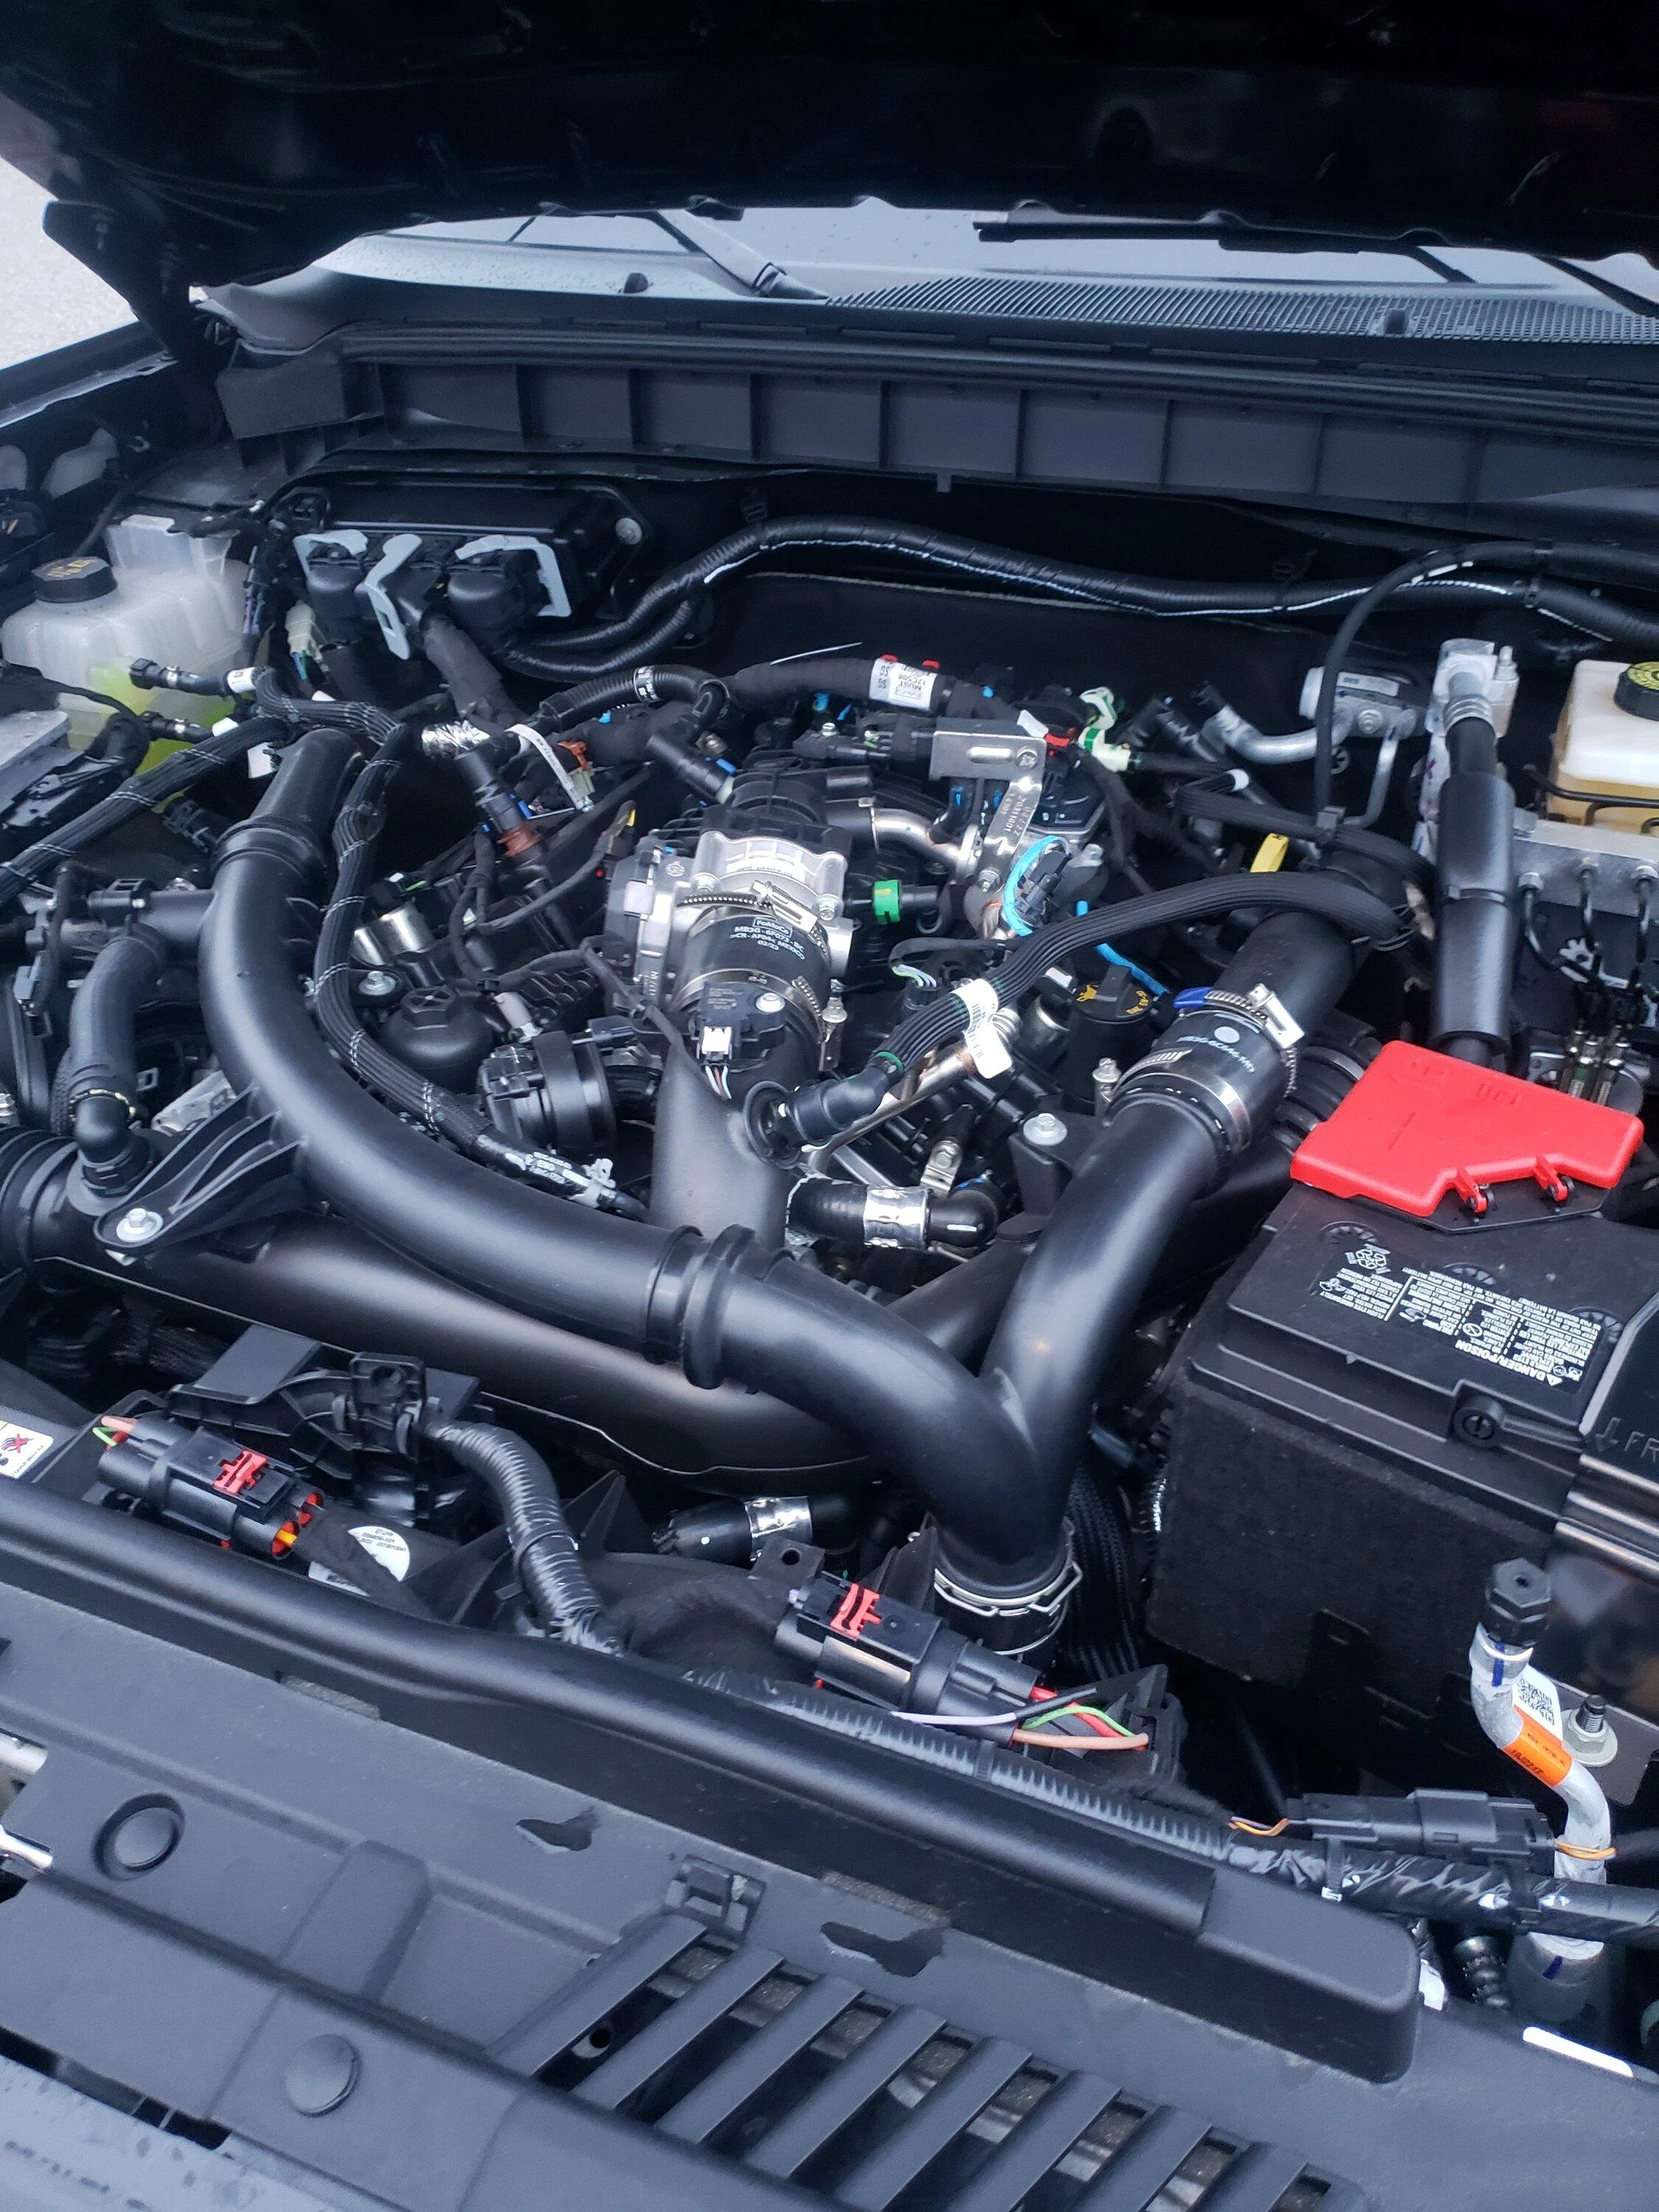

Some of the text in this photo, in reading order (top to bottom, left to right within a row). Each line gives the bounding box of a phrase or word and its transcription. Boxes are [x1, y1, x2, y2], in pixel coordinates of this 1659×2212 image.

[880, 665, 890, 677] SG
[900, 681, 922, 691] MUST
[757, 920, 790, 934] FoMoCo
[777, 941, 805, 960] MEXICO
[1454, 1338, 1546, 1382] DANGER/POISON
